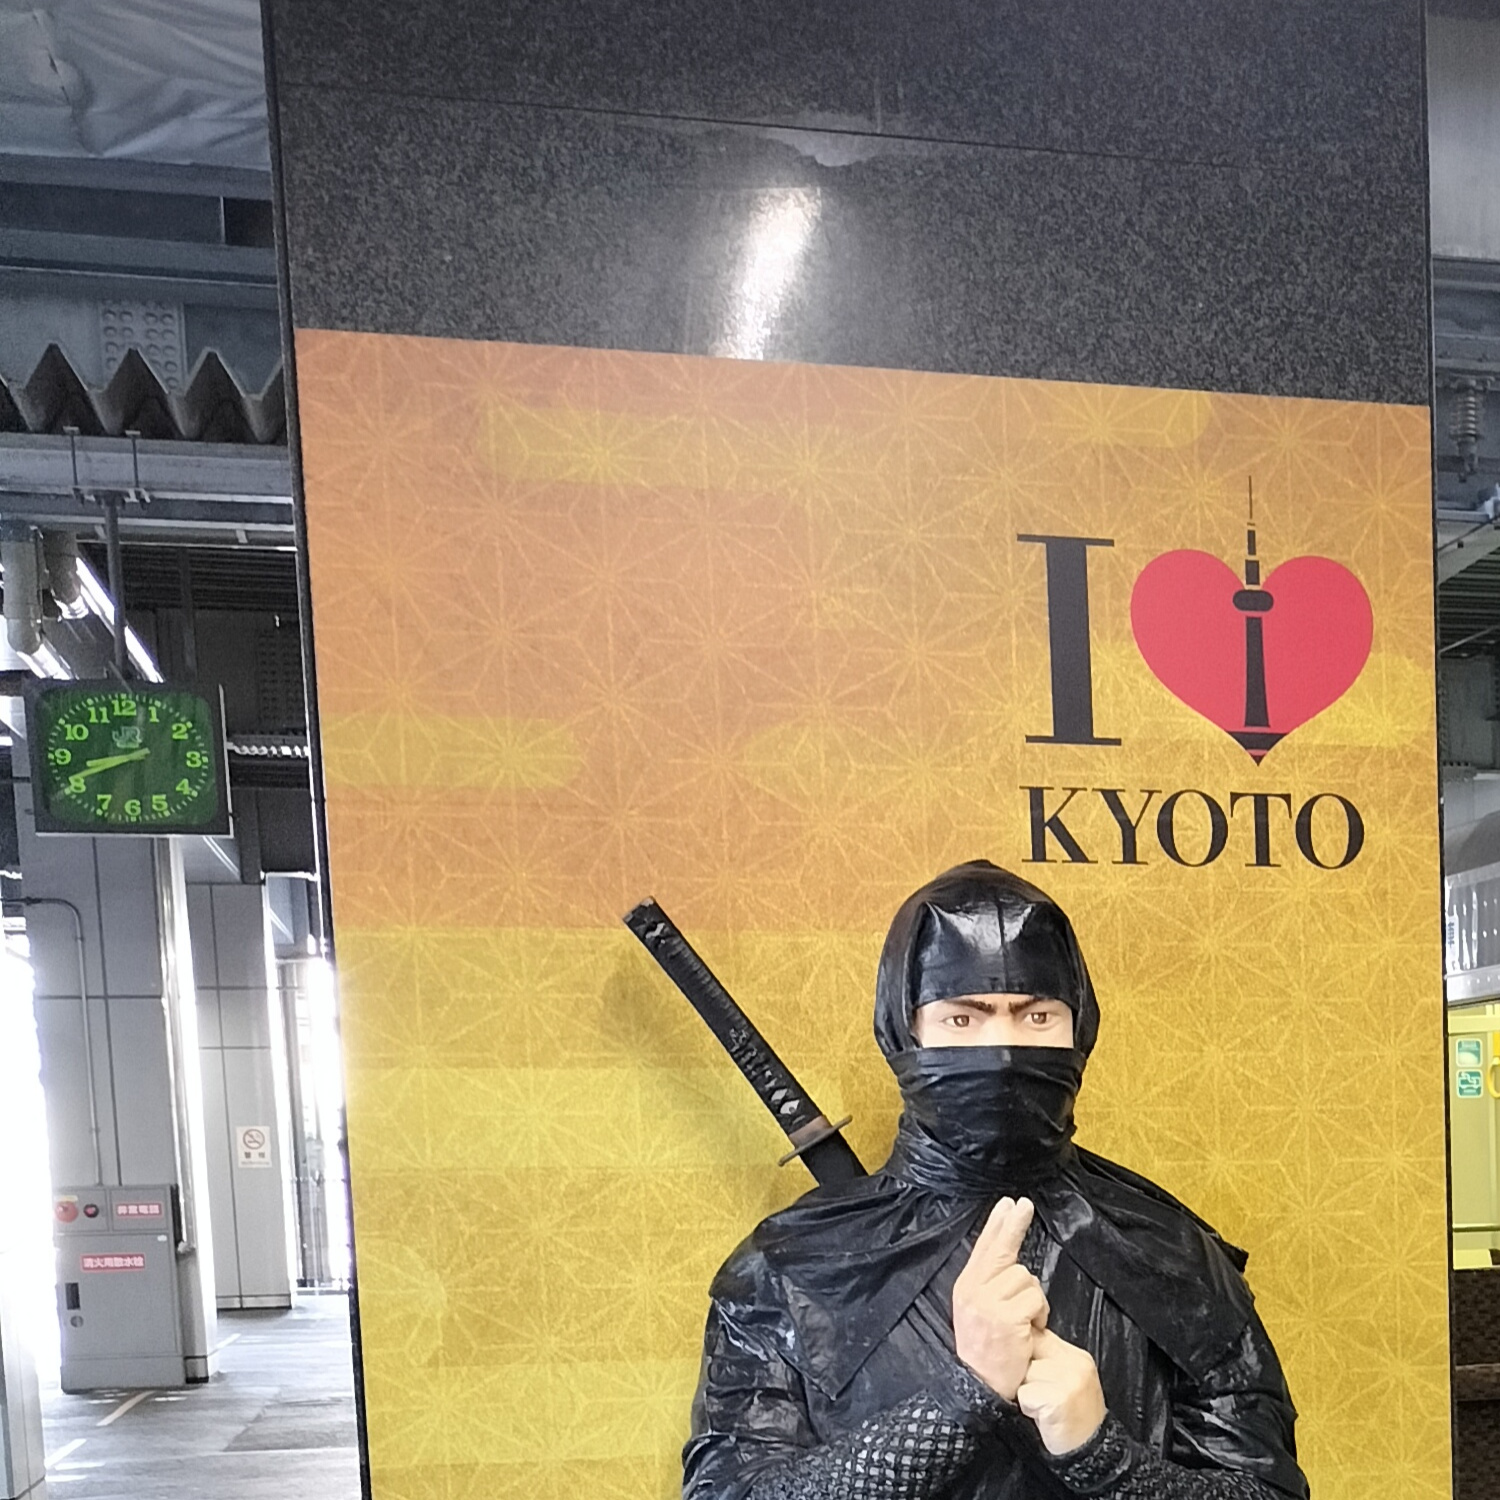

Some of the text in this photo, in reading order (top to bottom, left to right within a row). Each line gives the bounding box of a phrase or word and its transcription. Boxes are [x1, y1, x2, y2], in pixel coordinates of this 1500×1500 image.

[1017, 533, 1122, 747] I
[88, 706, 110, 724] 11
[112, 699, 137, 716] 12
[148, 706, 160, 723] 1
[64, 724, 89, 741] 10
[172, 723, 189, 740] 2
[54, 748, 71, 765] 9
[186, 751, 202, 768] 3
[70, 777, 86, 793] 8
[176, 778, 191, 795] 4
[97, 794, 112, 811] 7
[125, 799, 142, 817] 6
[152, 794, 168, 812] 5
[1019, 786, 1365, 870] KYOTO
